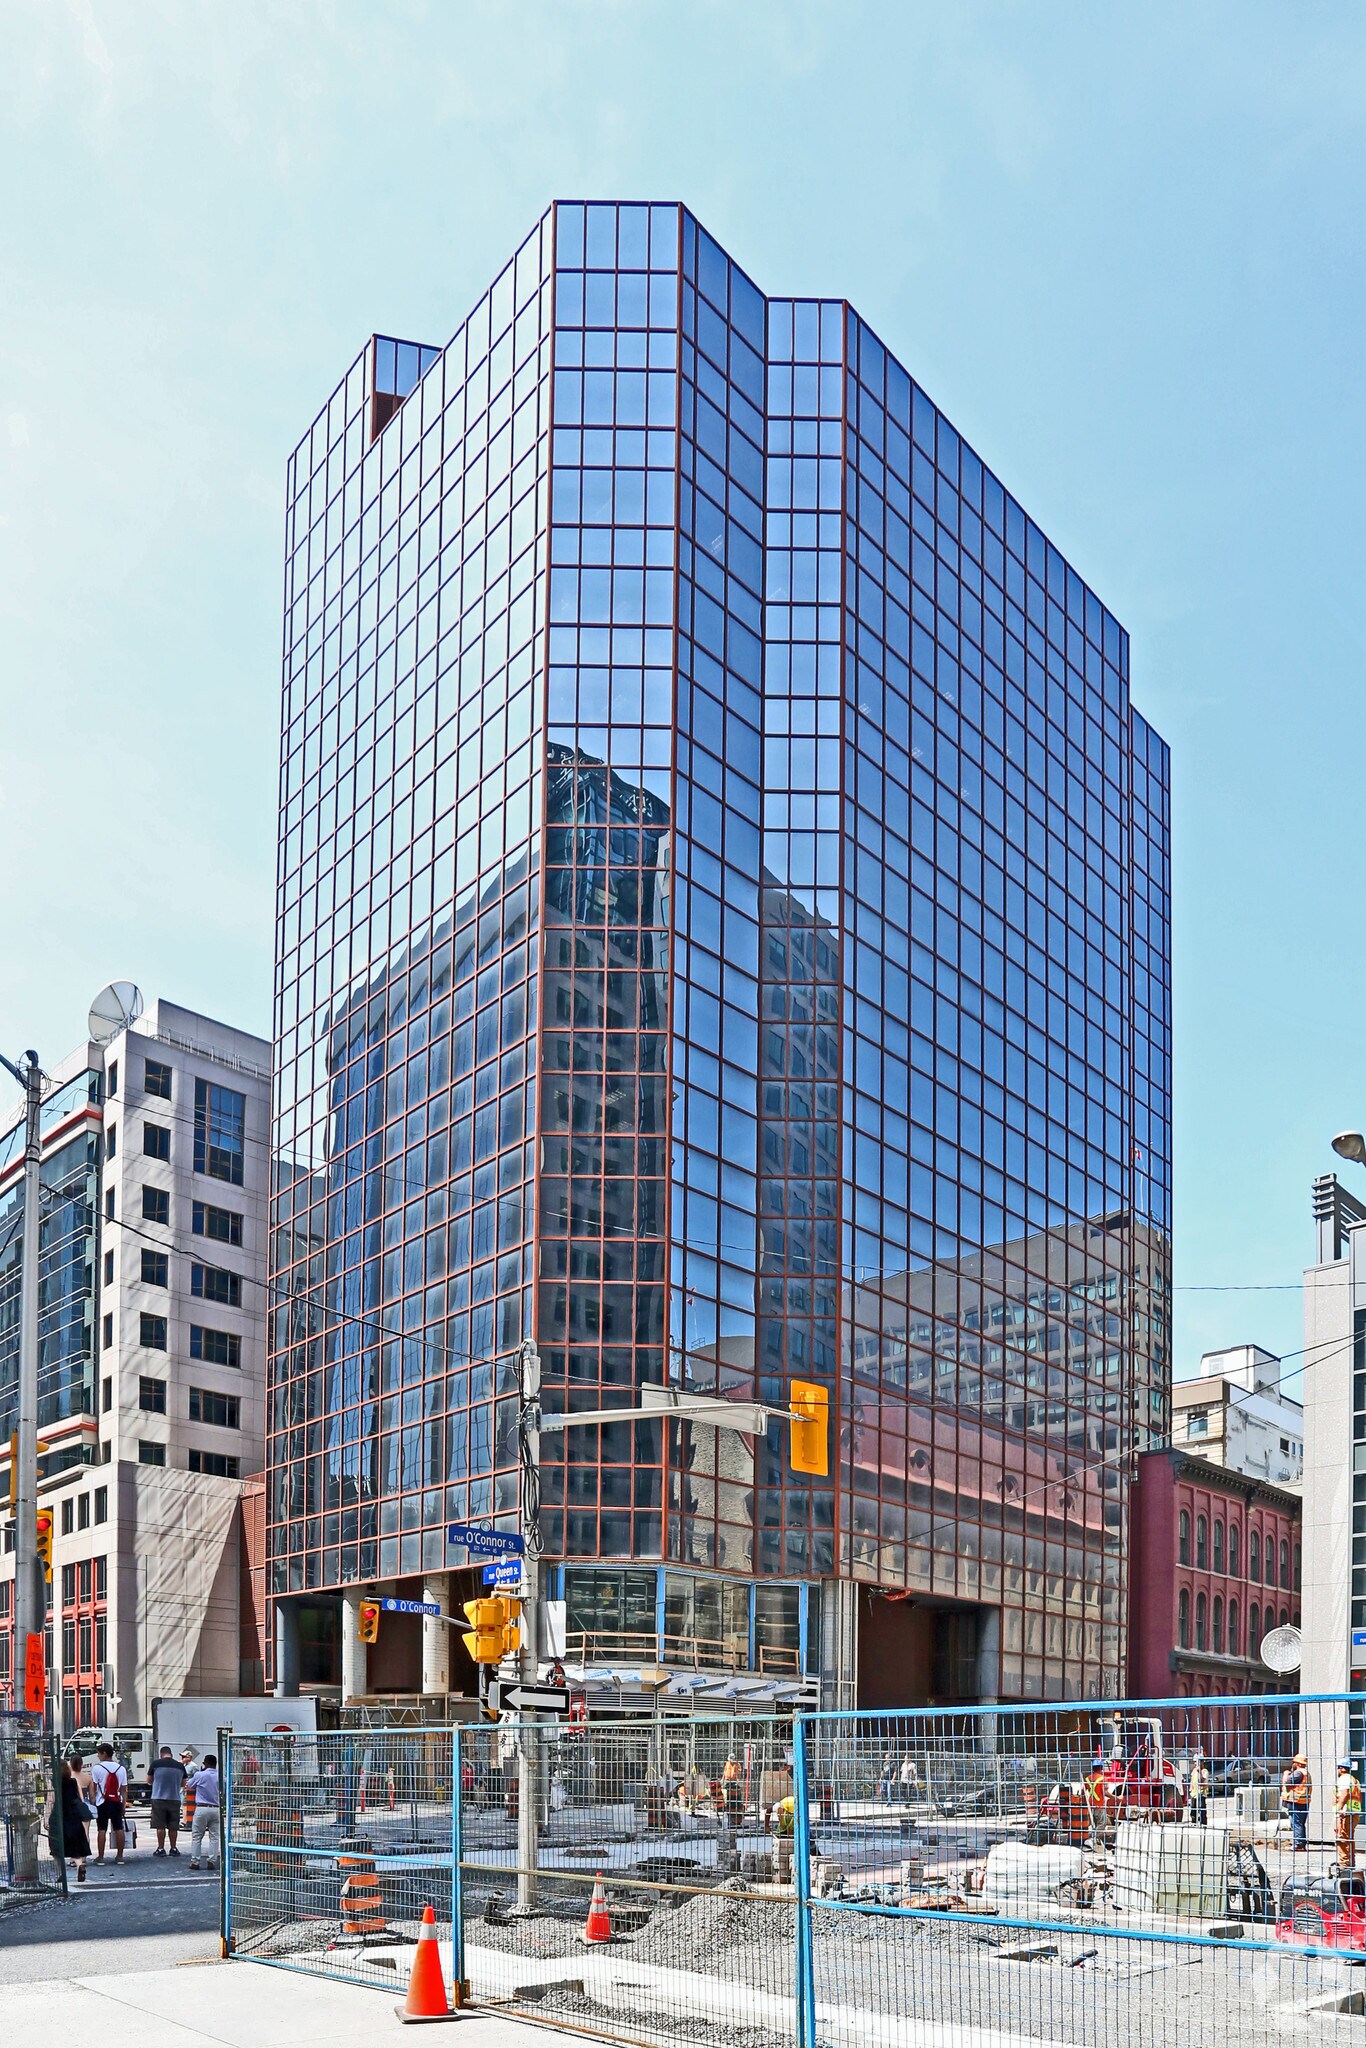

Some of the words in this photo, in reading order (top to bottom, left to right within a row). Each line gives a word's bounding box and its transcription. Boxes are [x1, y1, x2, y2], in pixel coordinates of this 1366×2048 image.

[454, 1535, 464, 1543] rue
[466, 1532, 506, 1548] O'Connor
[508, 1541, 516, 1549] St.
[495, 1566, 513, 1580] Queen
[400, 1600, 436, 1614] O'Connor
